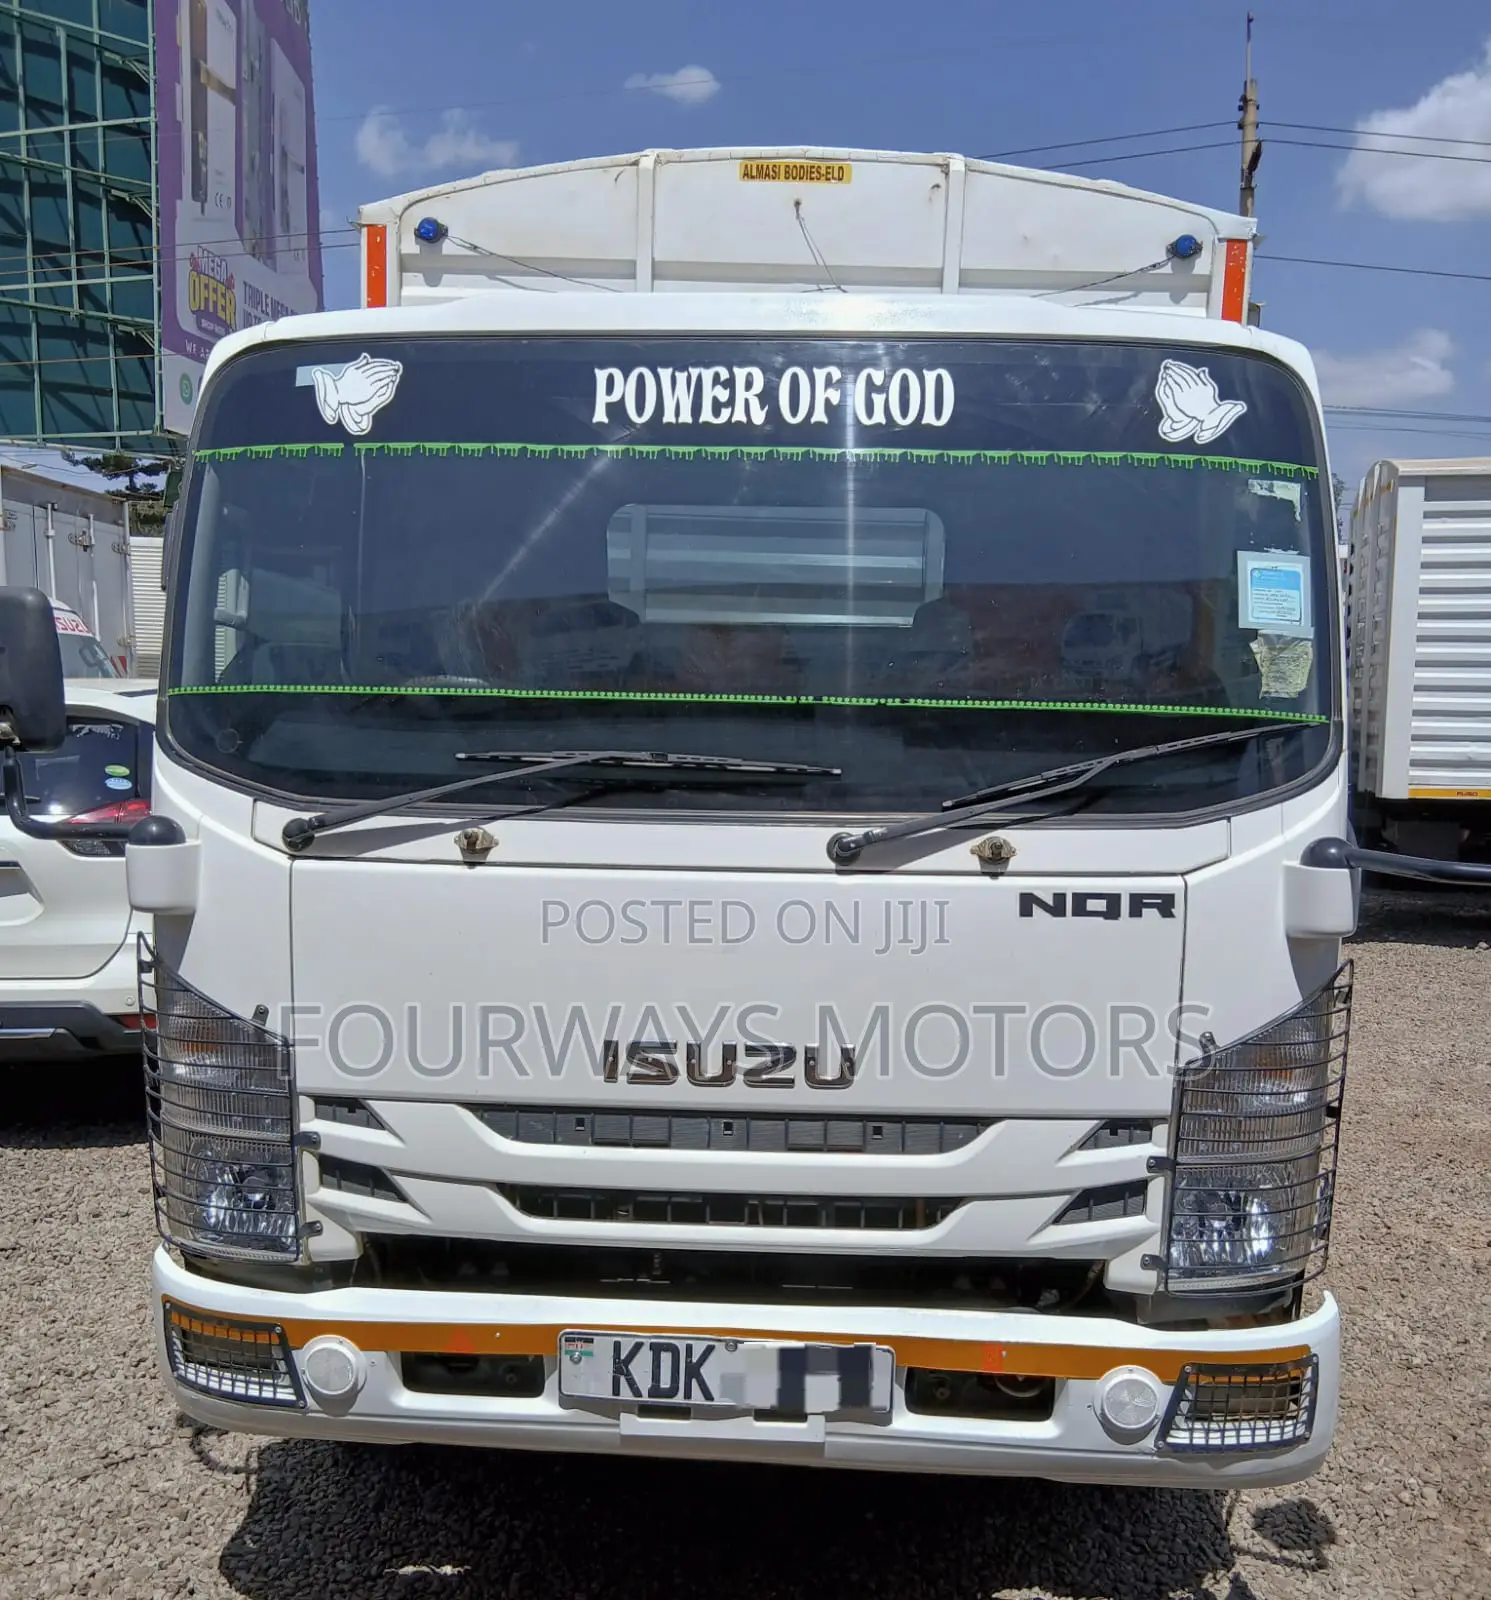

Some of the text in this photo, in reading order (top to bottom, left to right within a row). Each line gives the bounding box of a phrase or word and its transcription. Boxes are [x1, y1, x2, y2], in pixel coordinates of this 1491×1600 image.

[742, 164, 845, 181] ALMASI BODIES-ELD
[198, 245, 228, 283] MEGA
[189, 269, 237, 332] OFFER
[243, 280, 270, 317] TRIPLE
[592, 366, 955, 426] POWER OF GOD
[54, 616, 91, 634] SUZU
[1019, 892, 1176, 920] NQR
[603, 1038, 856, 1090] ISUZU
[612, 1340, 715, 1402] KDK
